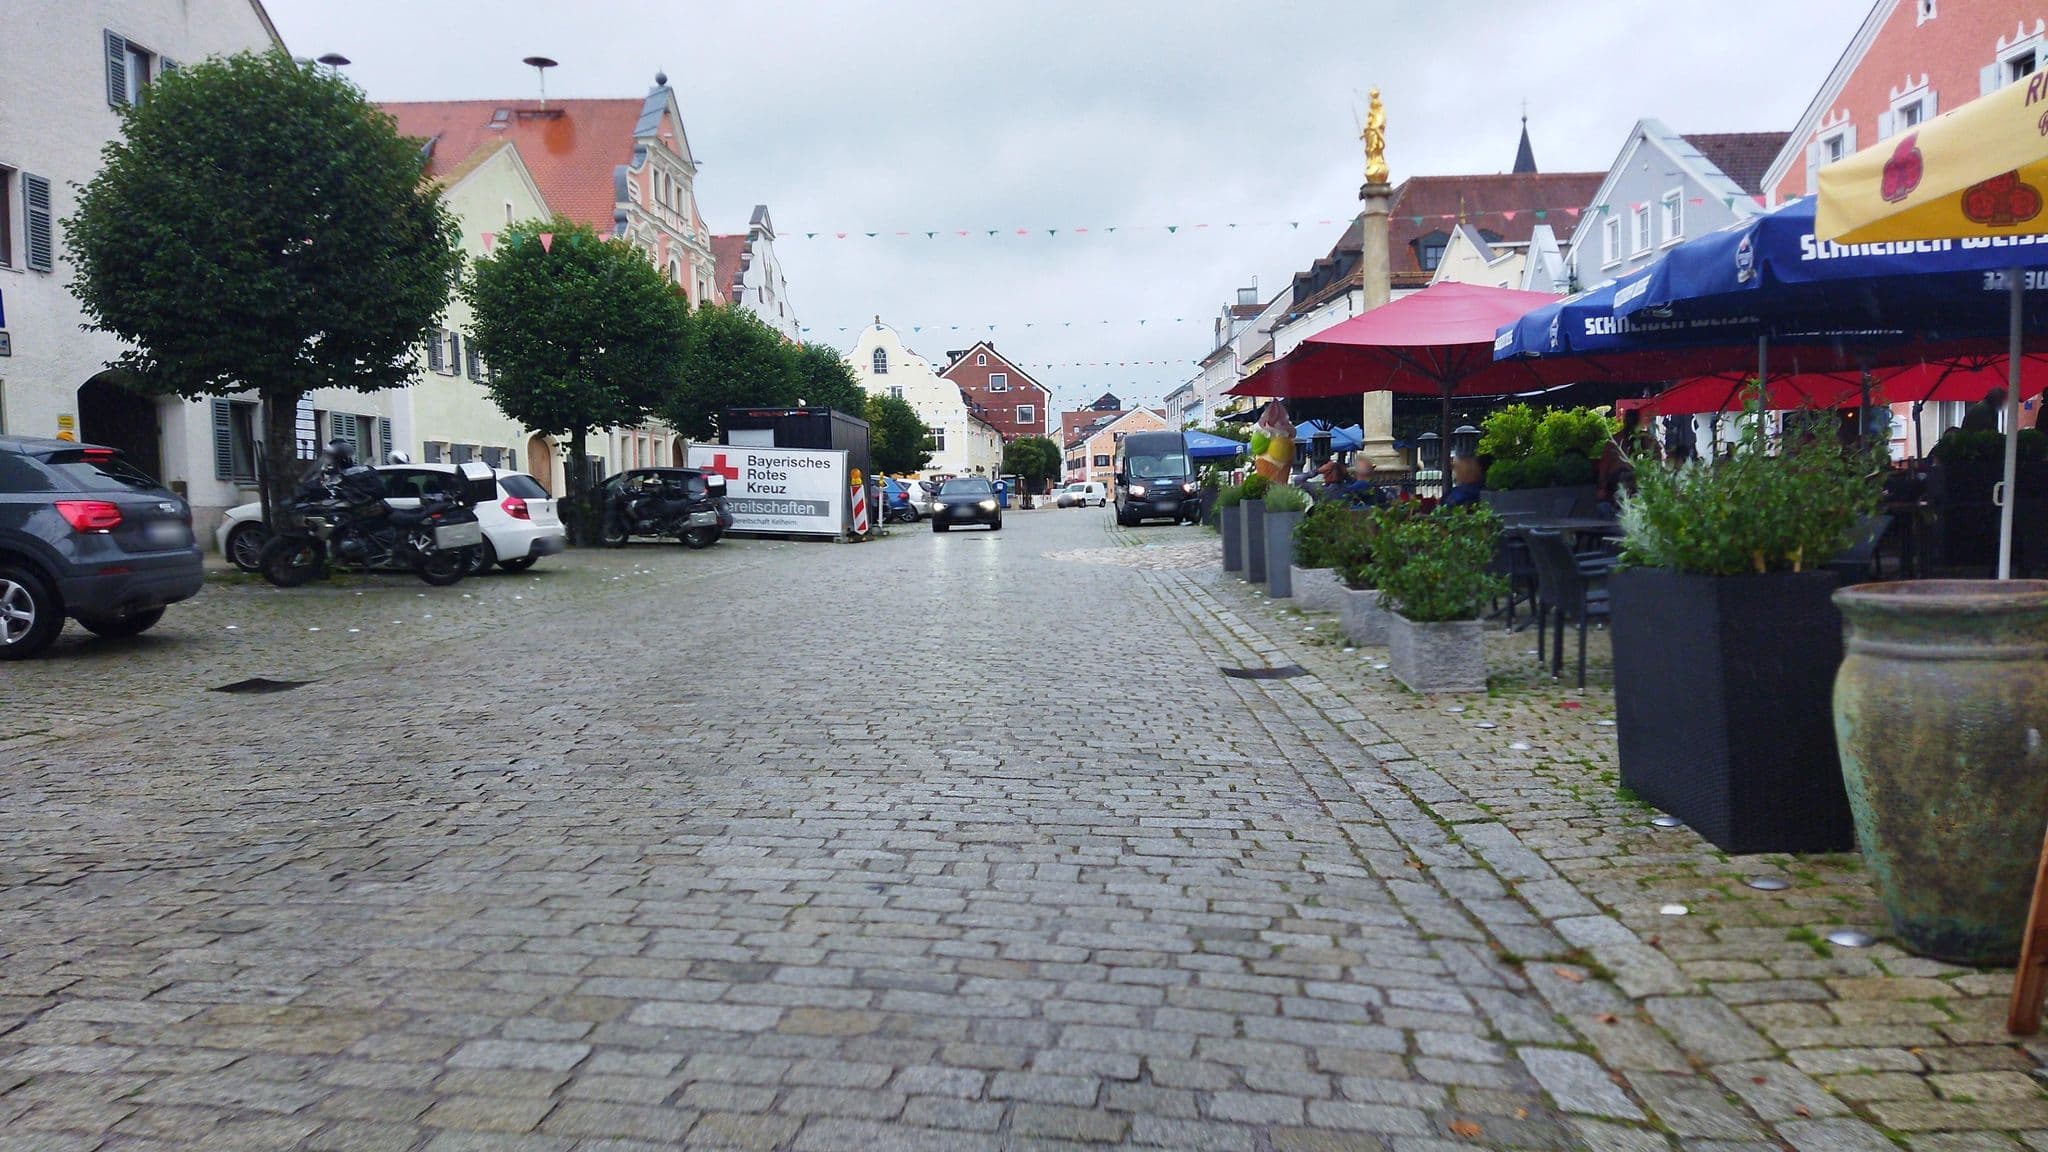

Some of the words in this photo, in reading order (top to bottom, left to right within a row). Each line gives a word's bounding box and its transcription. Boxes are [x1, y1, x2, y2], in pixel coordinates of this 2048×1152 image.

[747, 454, 831, 469] Bayerisches
[747, 468, 787, 480] Rotes
[747, 482, 787, 494] Kreuz
[728, 500, 815, 515] ereitschaften
